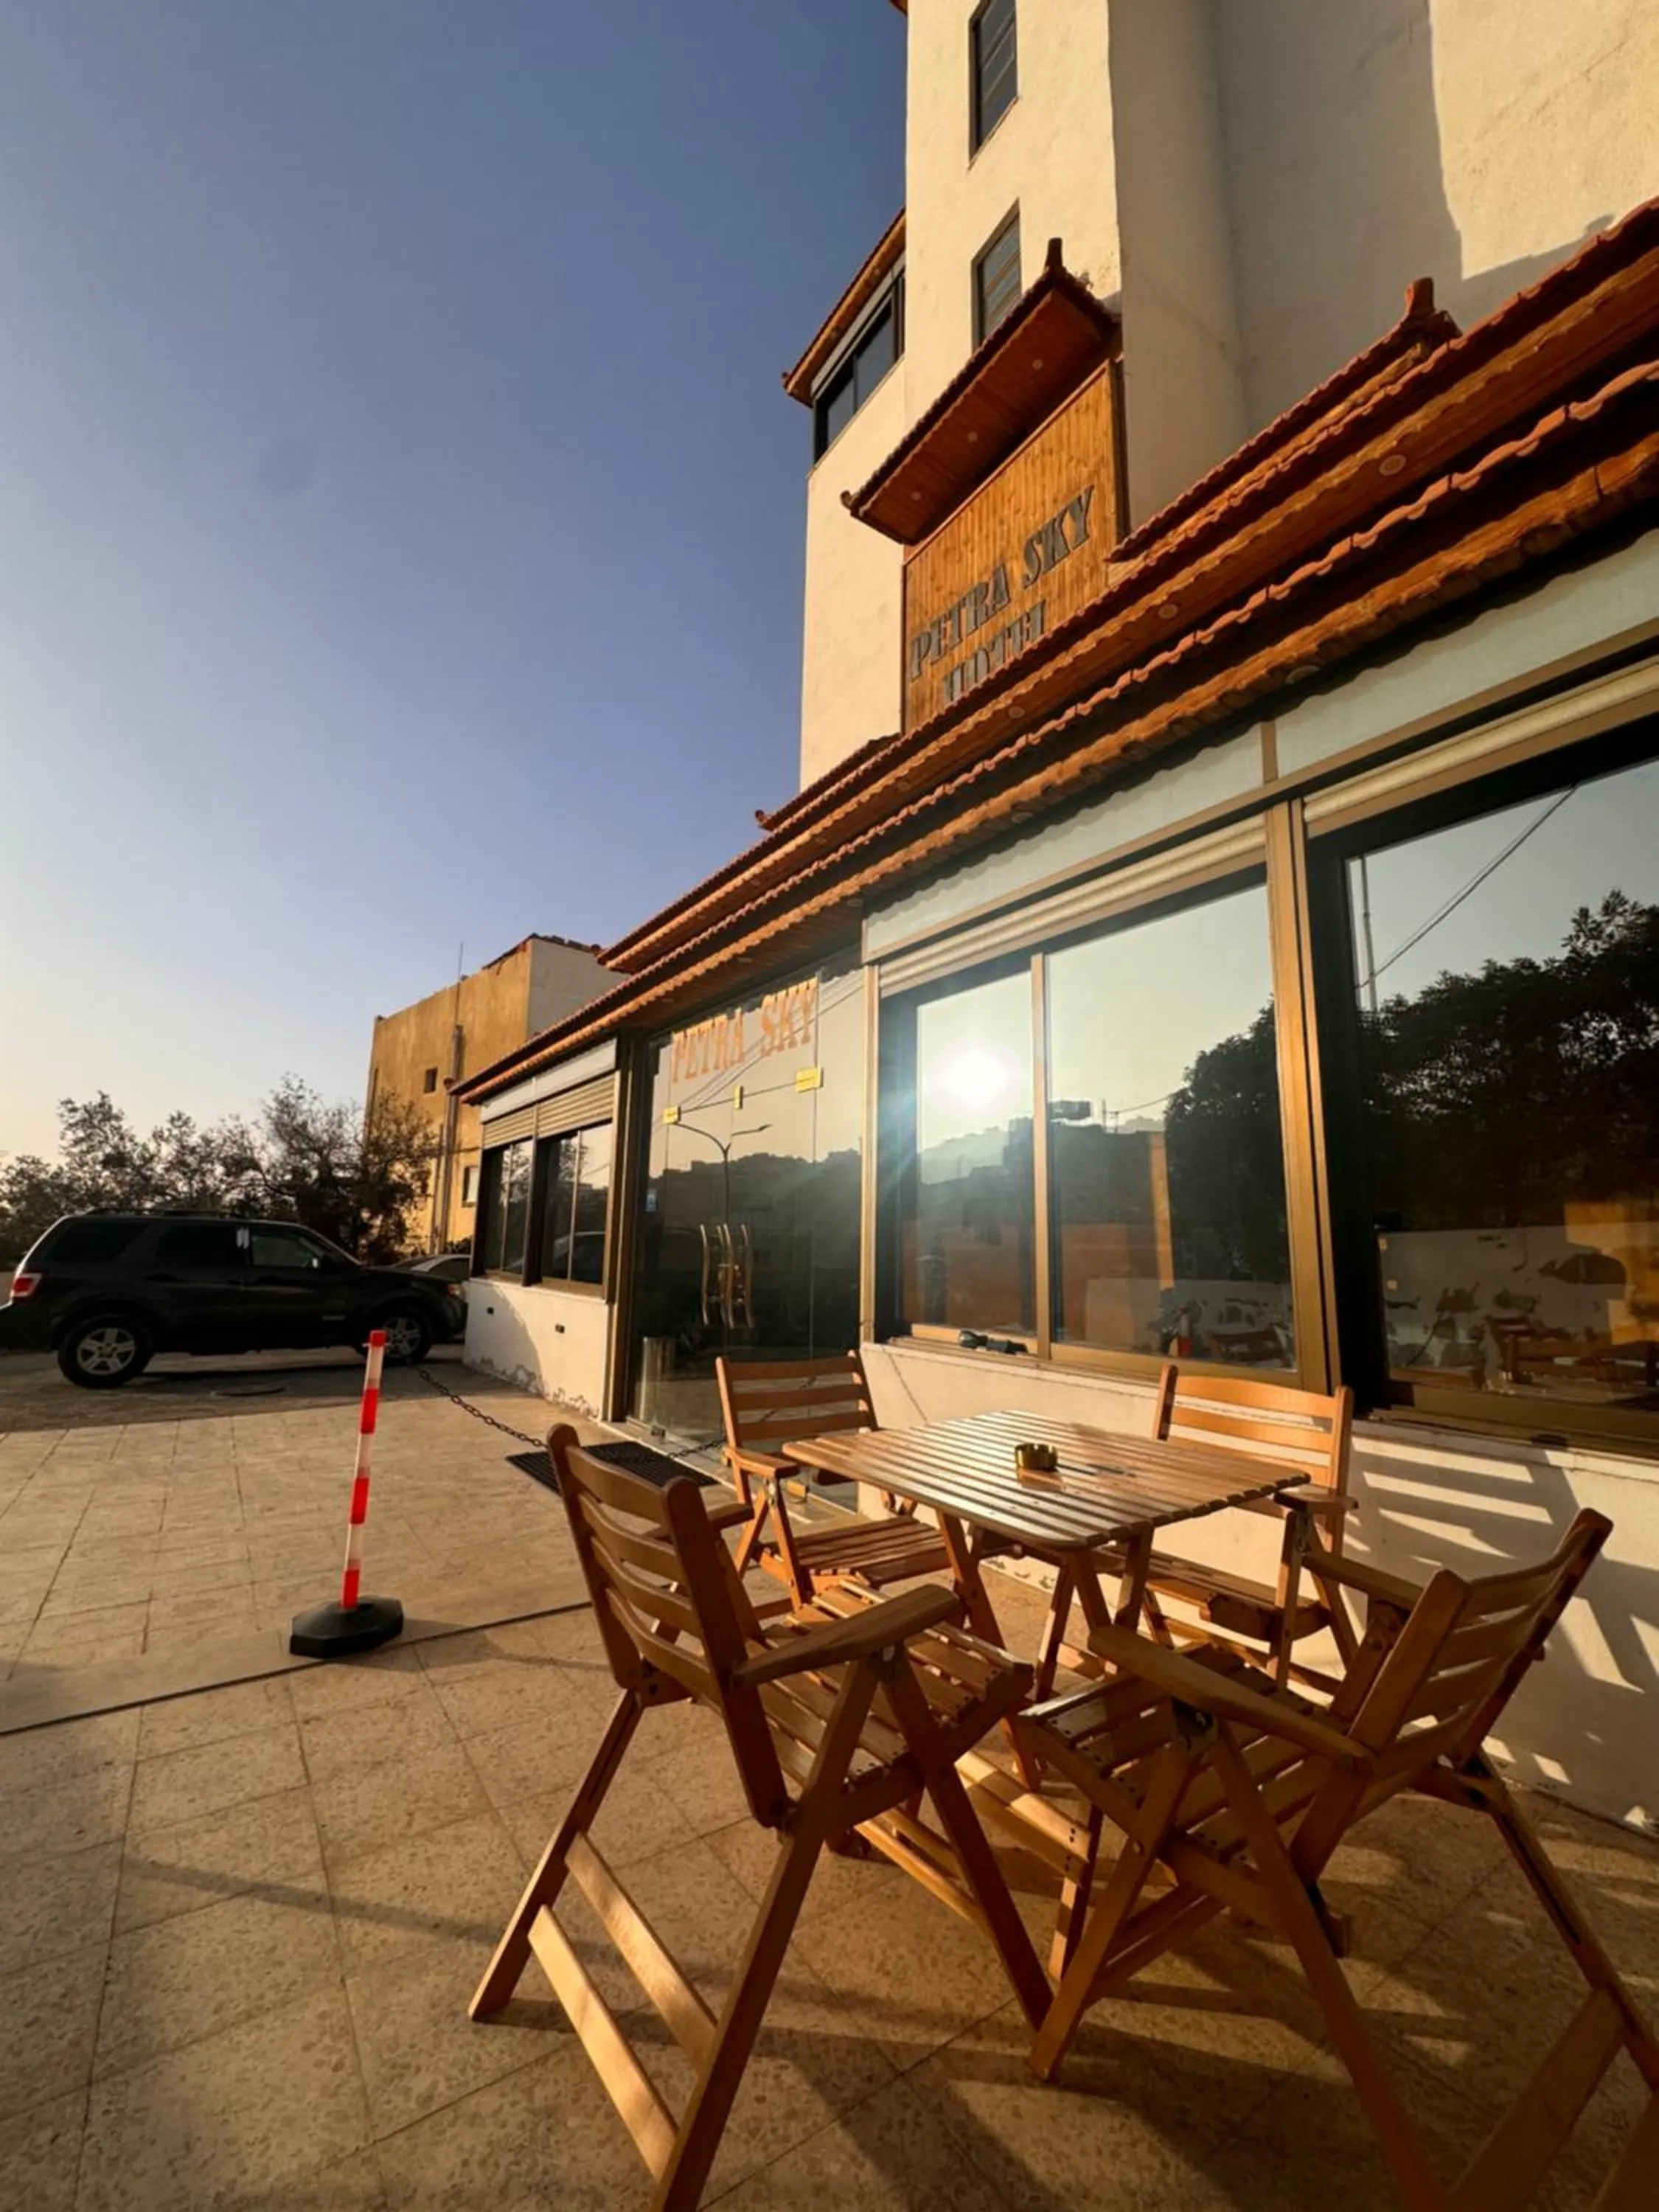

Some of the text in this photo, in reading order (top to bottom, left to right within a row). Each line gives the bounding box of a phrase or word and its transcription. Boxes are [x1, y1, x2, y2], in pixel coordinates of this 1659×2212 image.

[911, 484, 1095, 682] PETRA SKY
[672, 977, 818, 1084] PETRA SKY
